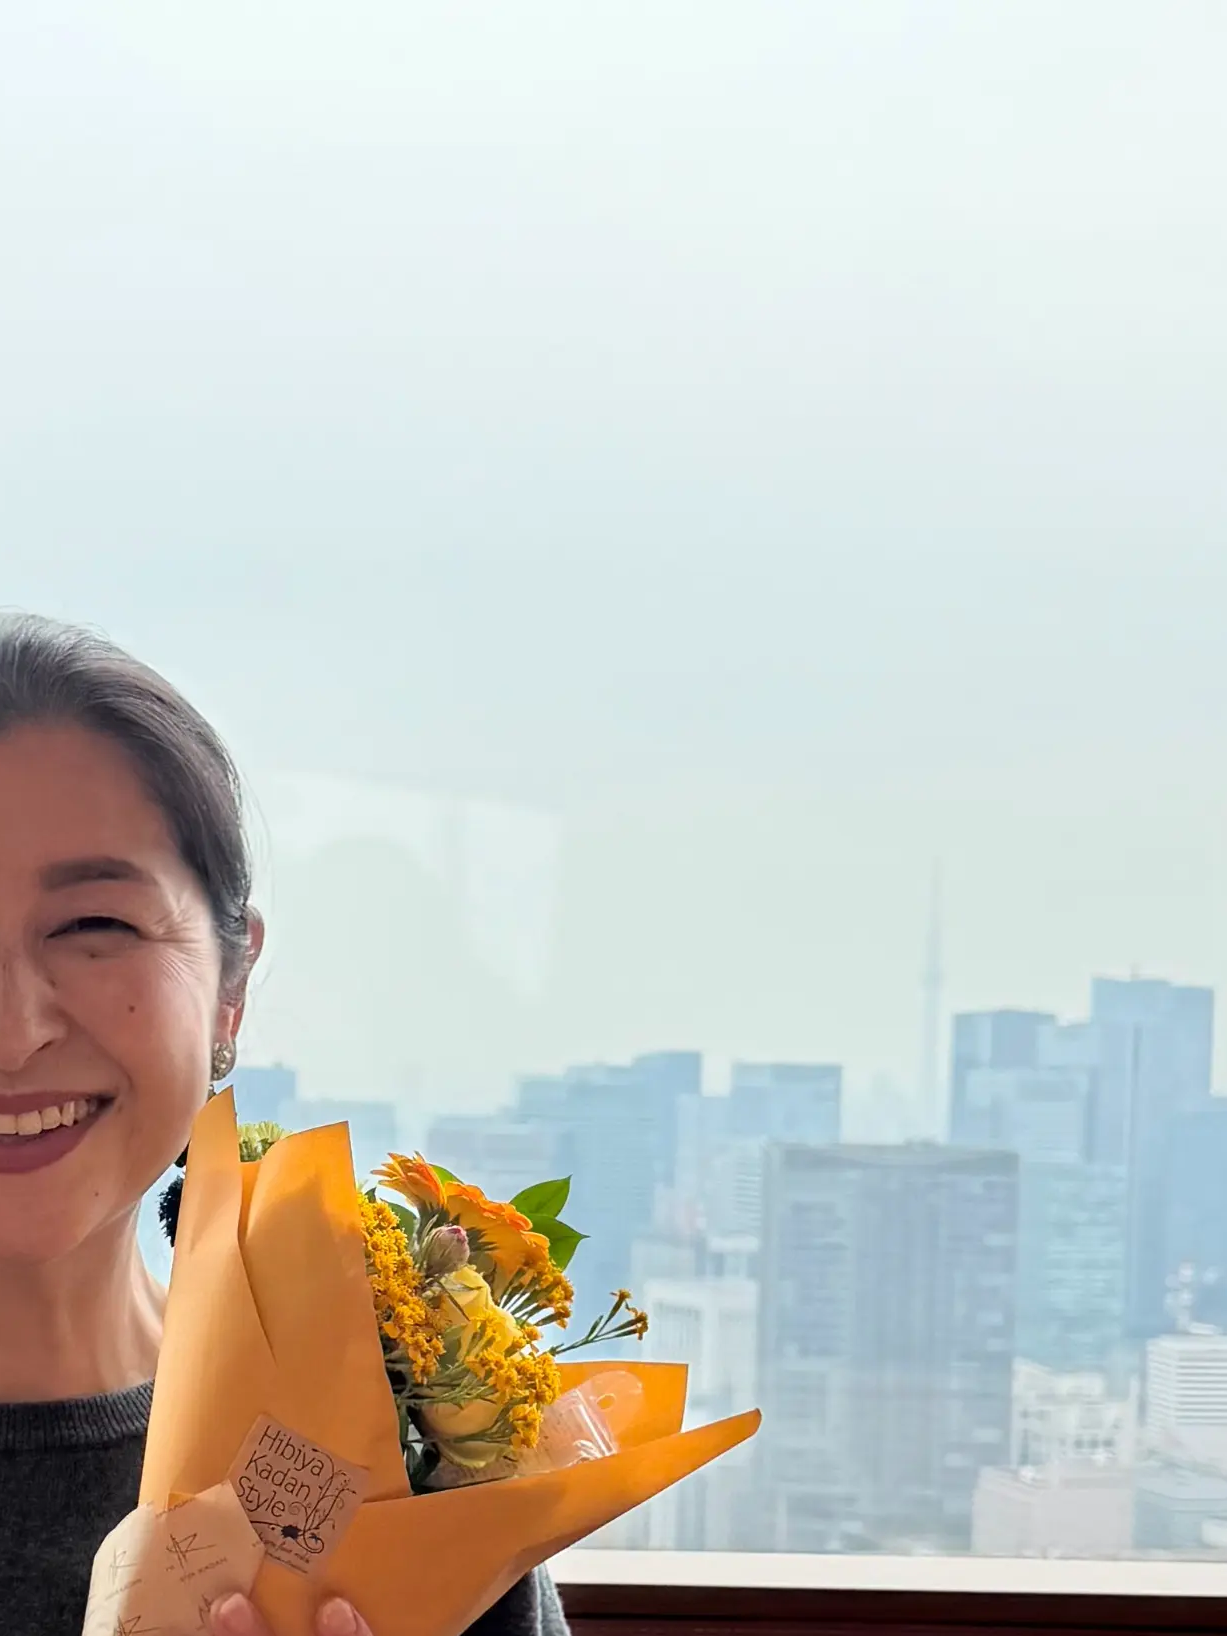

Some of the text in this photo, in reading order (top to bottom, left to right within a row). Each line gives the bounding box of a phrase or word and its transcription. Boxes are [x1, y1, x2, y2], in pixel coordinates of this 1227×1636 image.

[244, 1450, 311, 1501] Kadan
[258, 1424, 324, 1477] Hibiya
[236, 1475, 286, 1518] Style
